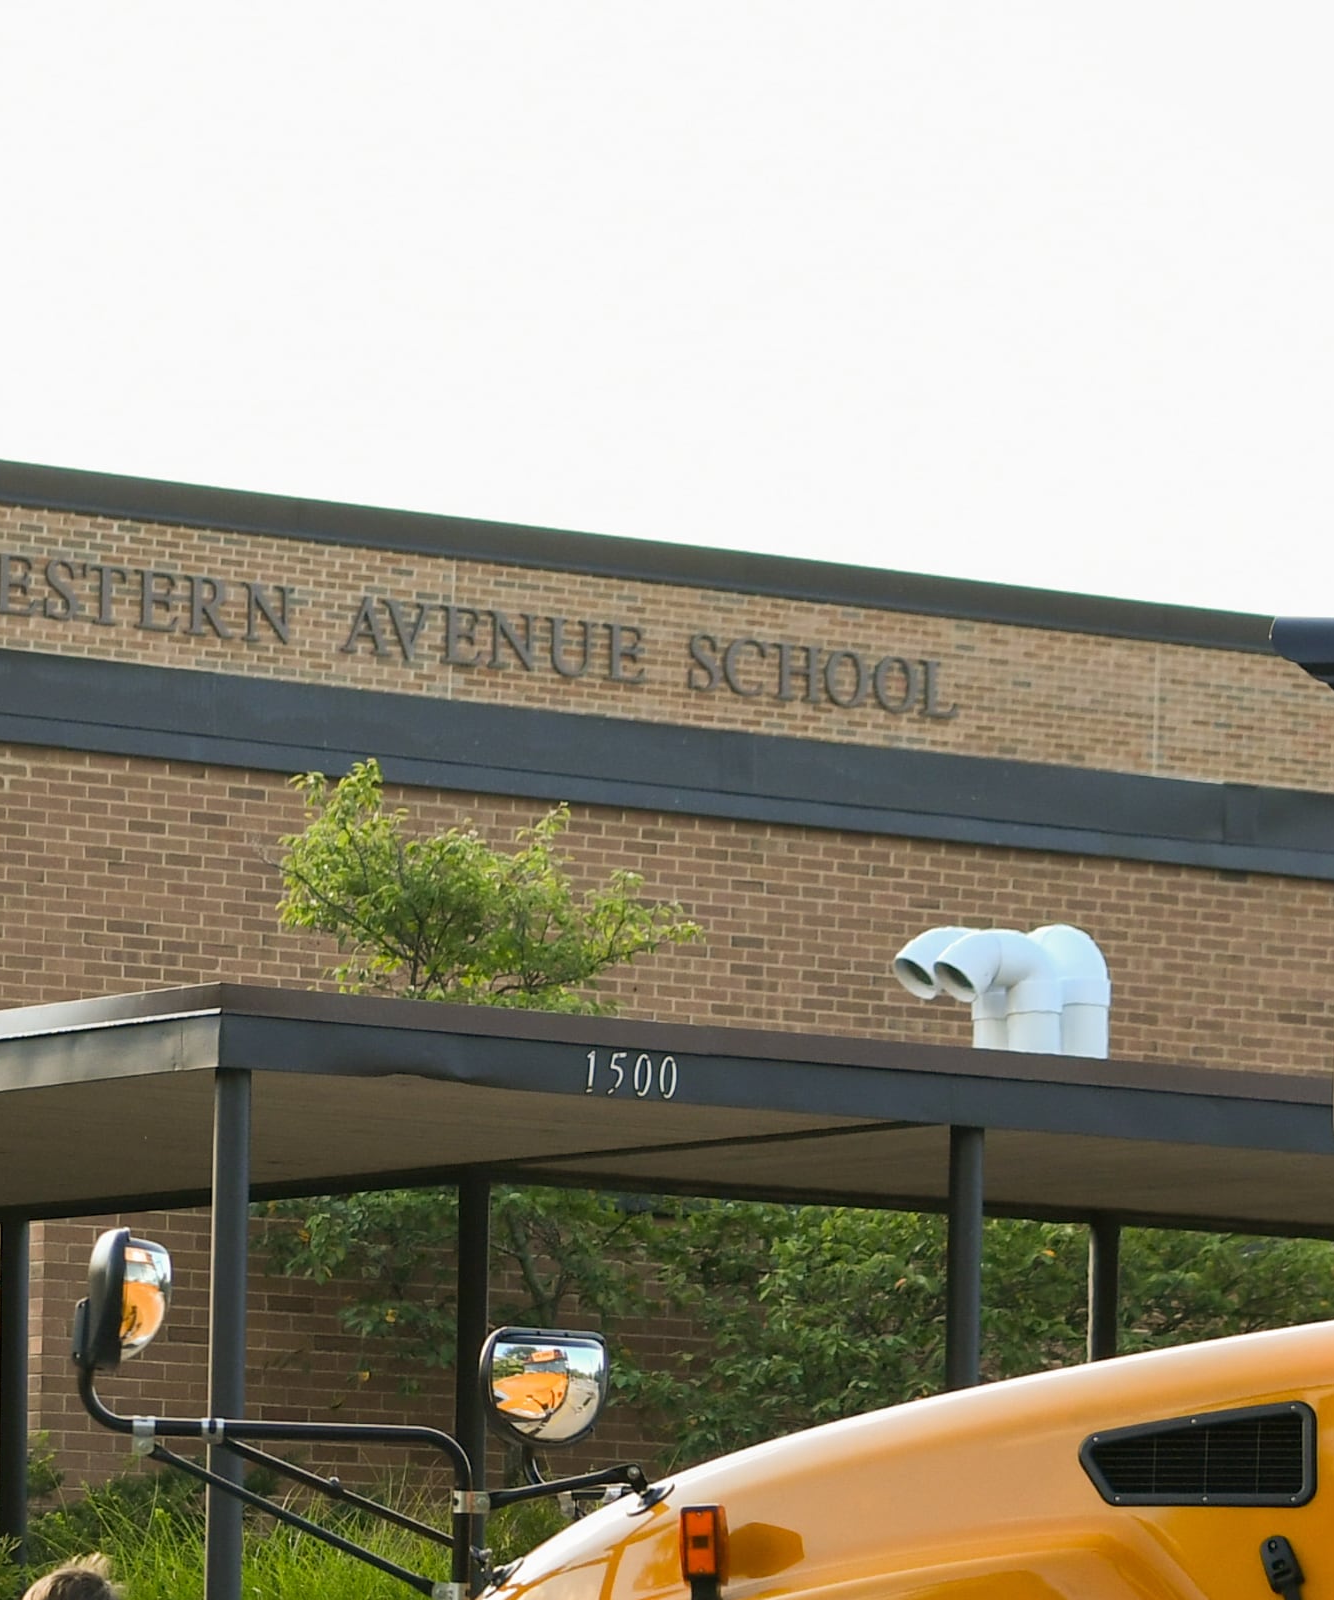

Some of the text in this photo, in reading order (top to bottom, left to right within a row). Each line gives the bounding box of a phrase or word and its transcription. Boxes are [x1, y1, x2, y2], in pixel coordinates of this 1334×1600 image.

[339, 596, 646, 684] AVENUE
[686, 633, 959, 720] SCHOOL
[585, 1050, 678, 1099] 1500
